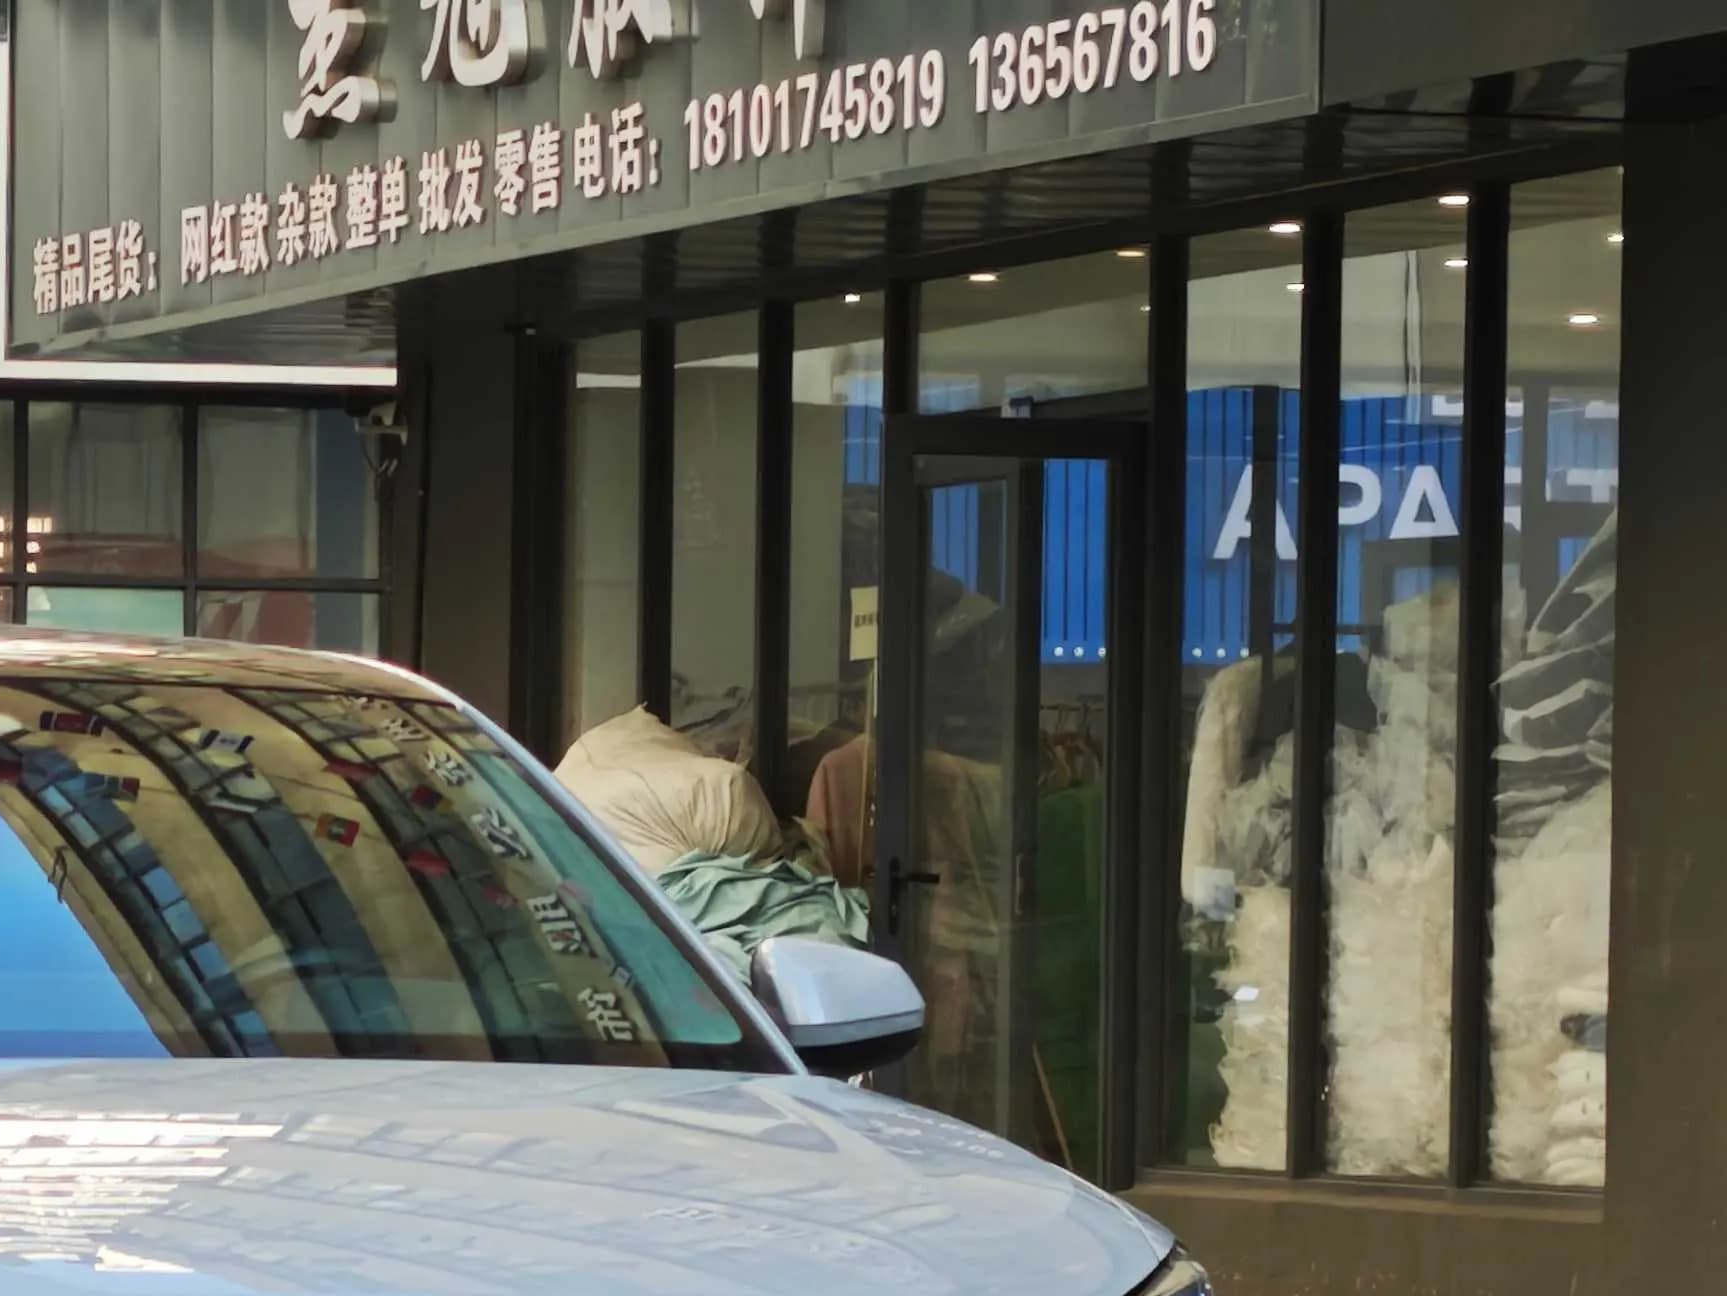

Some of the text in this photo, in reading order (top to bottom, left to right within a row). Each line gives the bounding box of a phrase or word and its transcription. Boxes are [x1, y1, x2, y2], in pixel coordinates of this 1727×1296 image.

[180, 193, 270, 286] 网红款
[276, 173, 340, 266] 杂款
[345, 154, 410, 250] 整单
[417, 138, 486, 236] 批发
[493, 121, 563, 216] 零售
[683, 49, 945, 172] 18101745819
[967, 0, 1217, 114] 136567816
